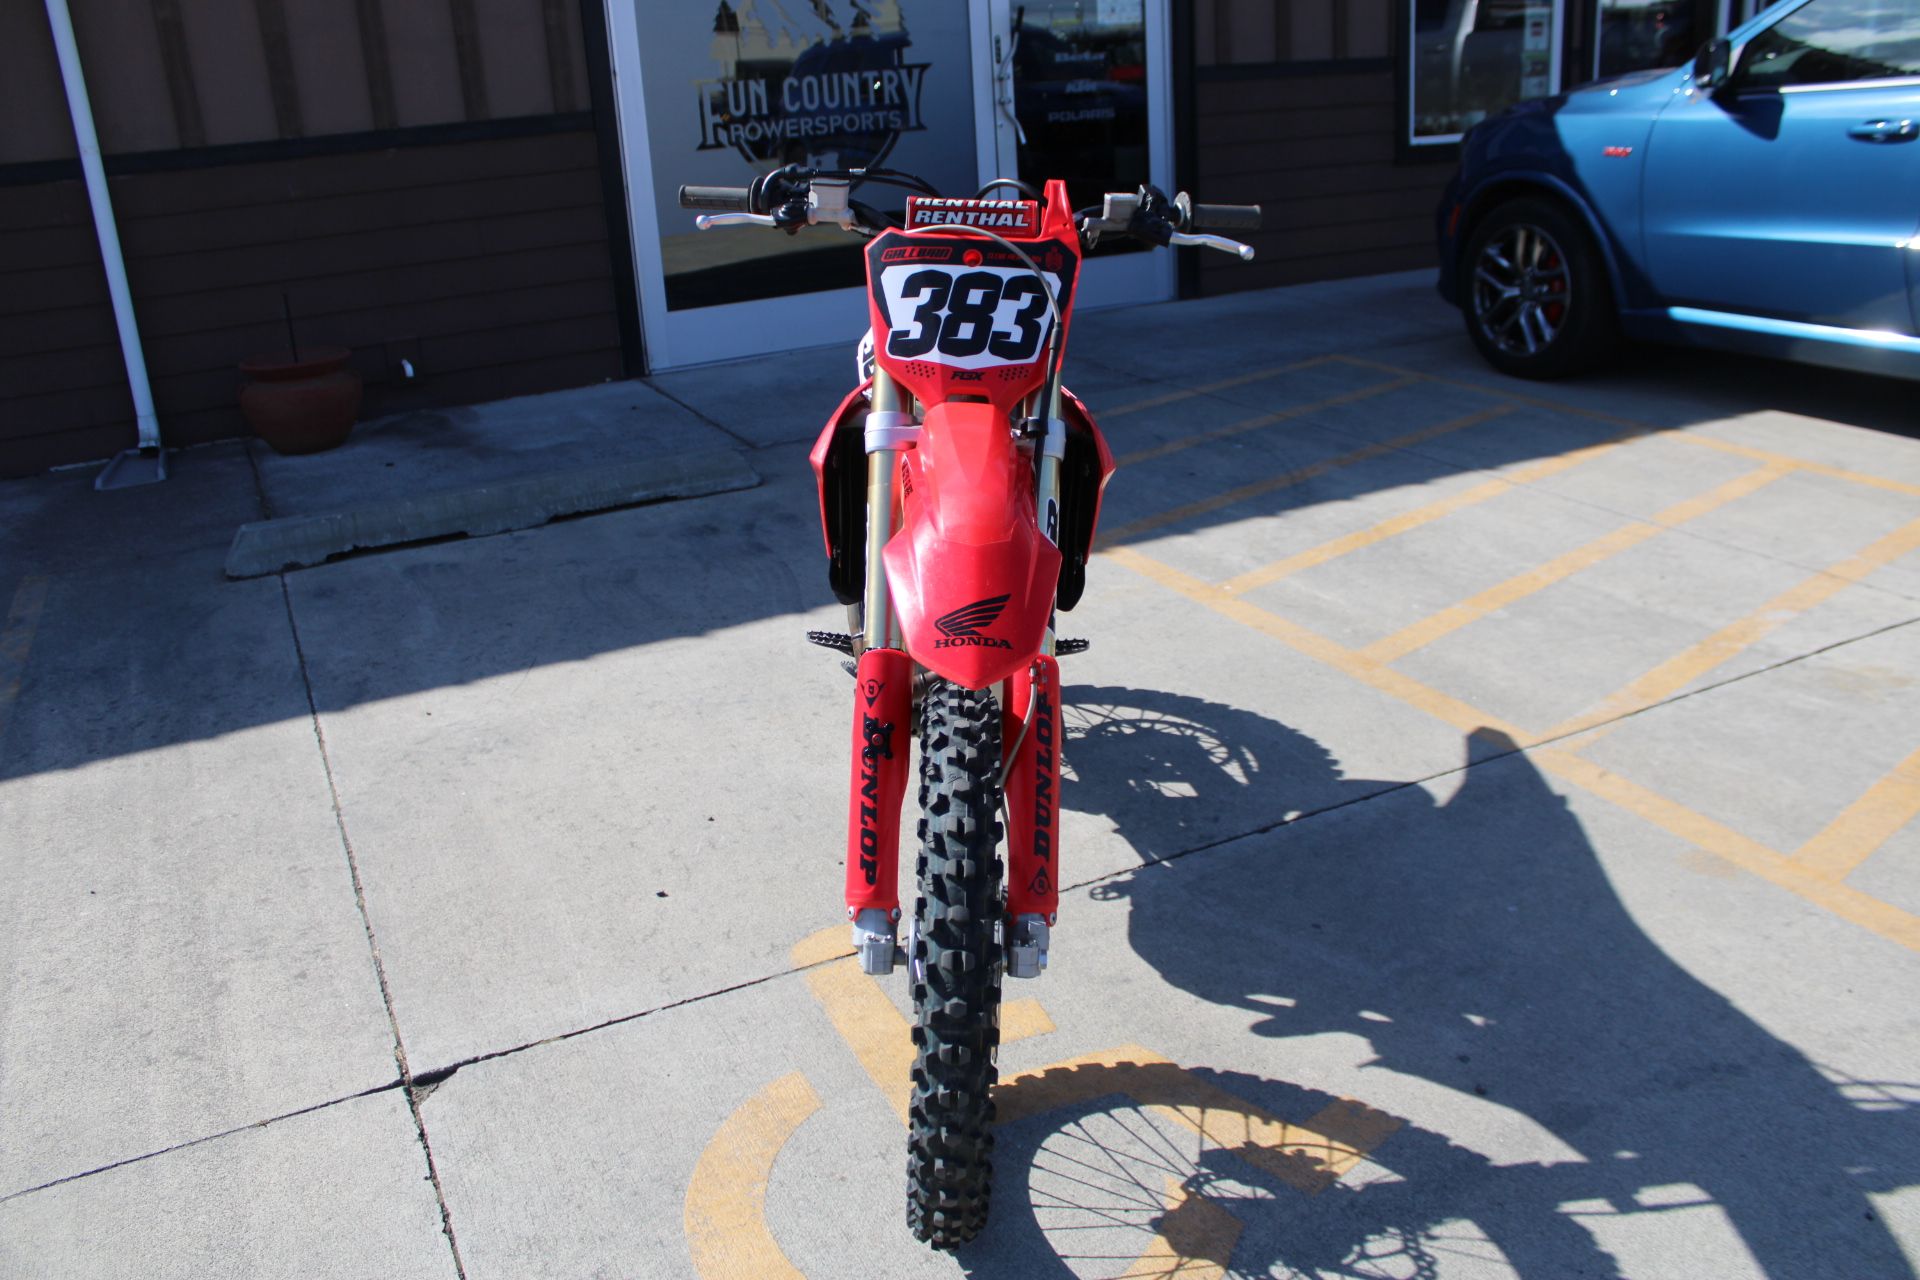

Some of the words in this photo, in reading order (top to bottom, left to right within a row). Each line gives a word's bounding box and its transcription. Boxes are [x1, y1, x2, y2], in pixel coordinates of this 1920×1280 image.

[697, 78, 769, 150] FUN
[783, 64, 930, 132] COUNTRY
[730, 110, 902, 142] POWERSPORTS
[914, 210, 1030, 227] RENTHAL
[887, 269, 1052, 361] 383
[934, 637, 1014, 650] HONDA
